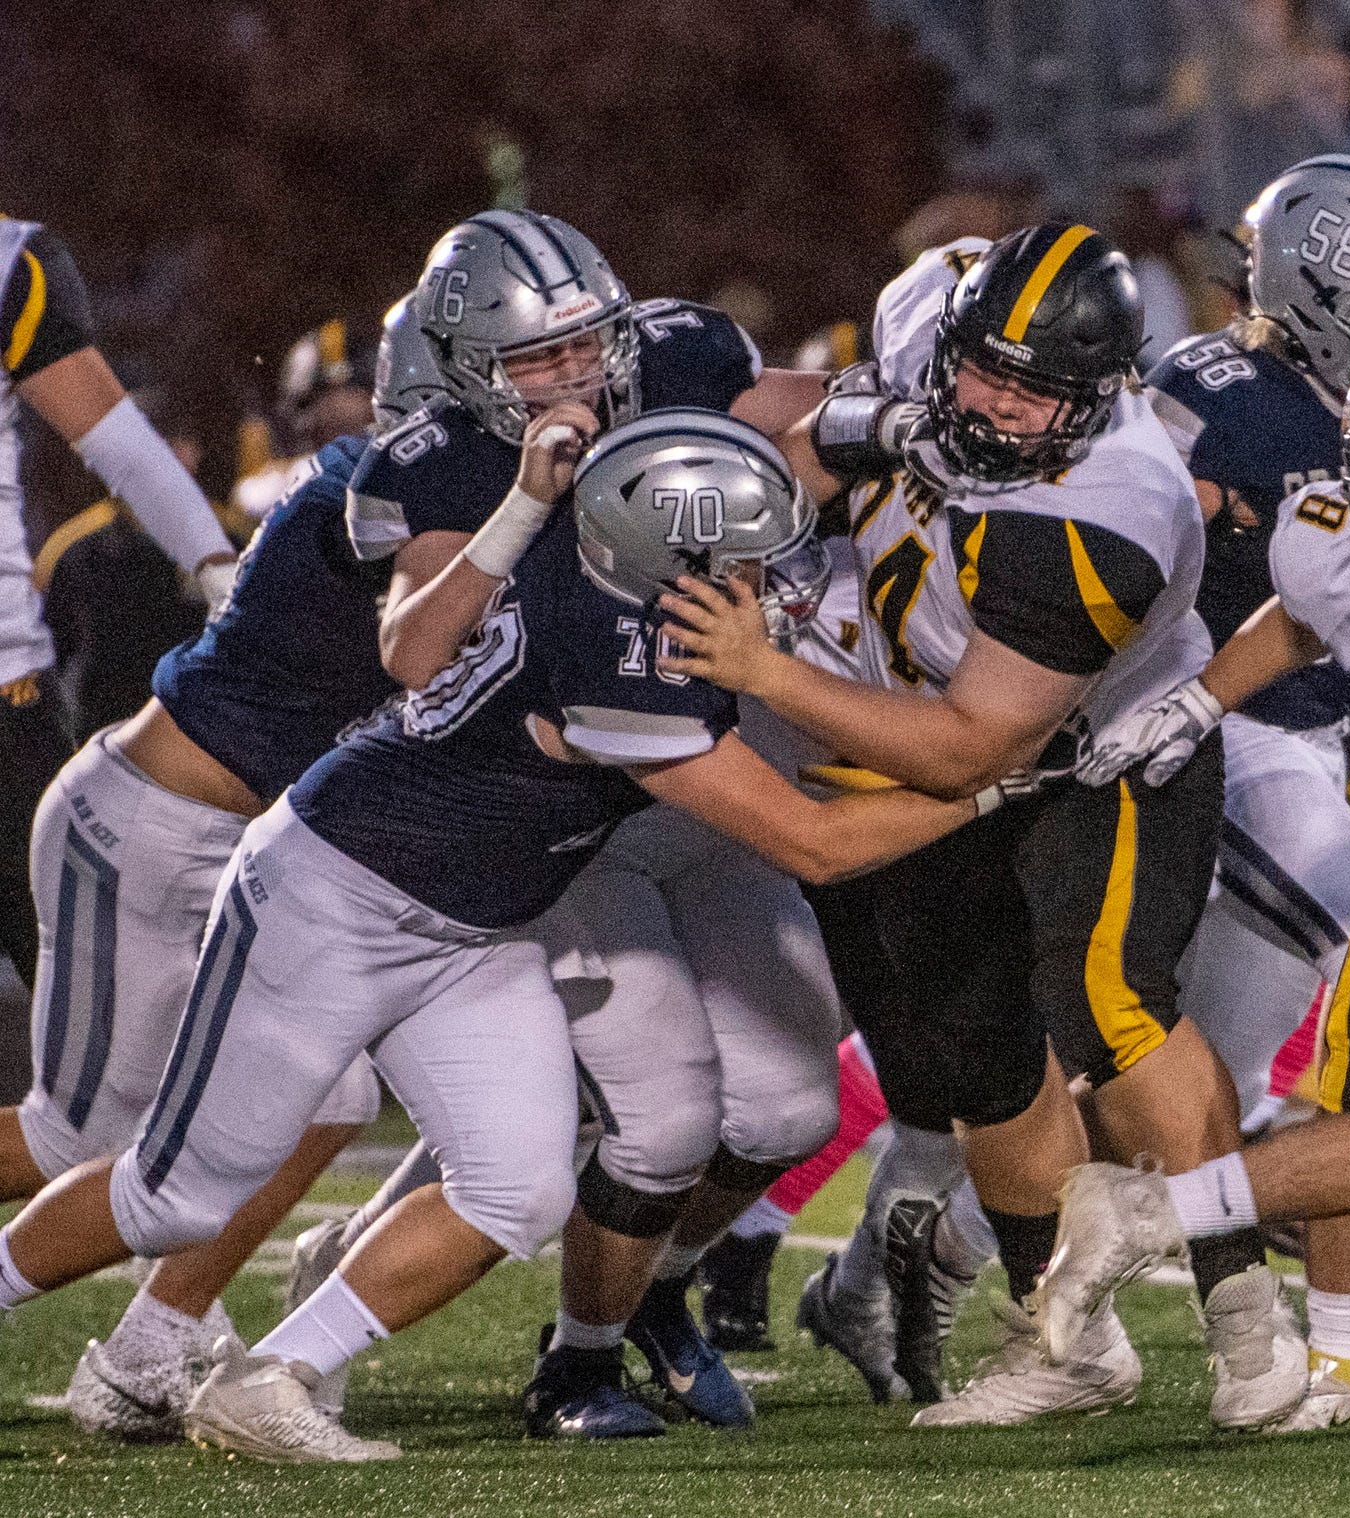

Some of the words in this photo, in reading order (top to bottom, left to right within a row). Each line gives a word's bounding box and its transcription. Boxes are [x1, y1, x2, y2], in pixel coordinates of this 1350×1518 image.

[427, 266, 471, 326] 76
[1174, 336, 1257, 391] 58
[653, 487, 725, 544] 70
[1295, 493, 1350, 535] 8
